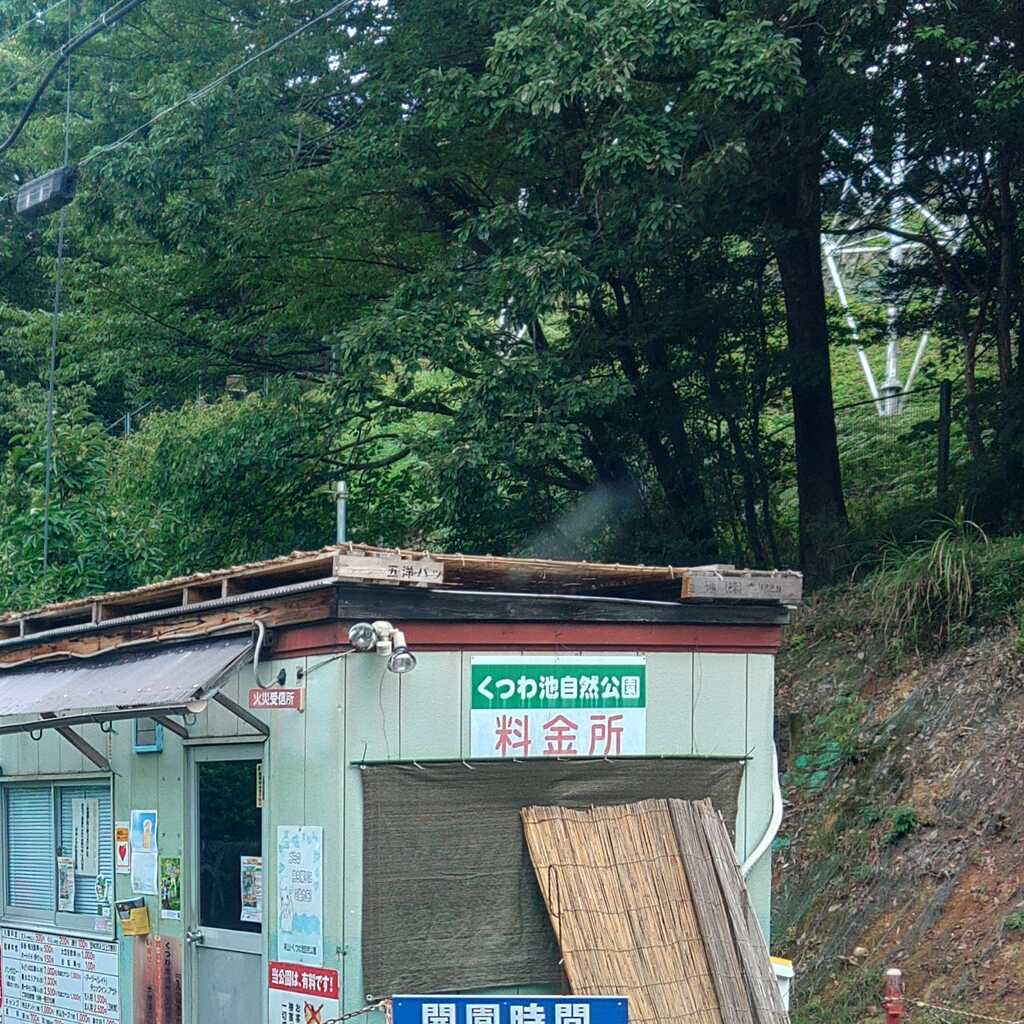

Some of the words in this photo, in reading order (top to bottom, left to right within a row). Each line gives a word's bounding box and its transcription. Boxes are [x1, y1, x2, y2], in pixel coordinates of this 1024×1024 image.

[252, 690, 296, 708] 火災受信所
[476, 673, 641, 702] くつわ池自然公園
[494, 713, 625, 757] 料金所
